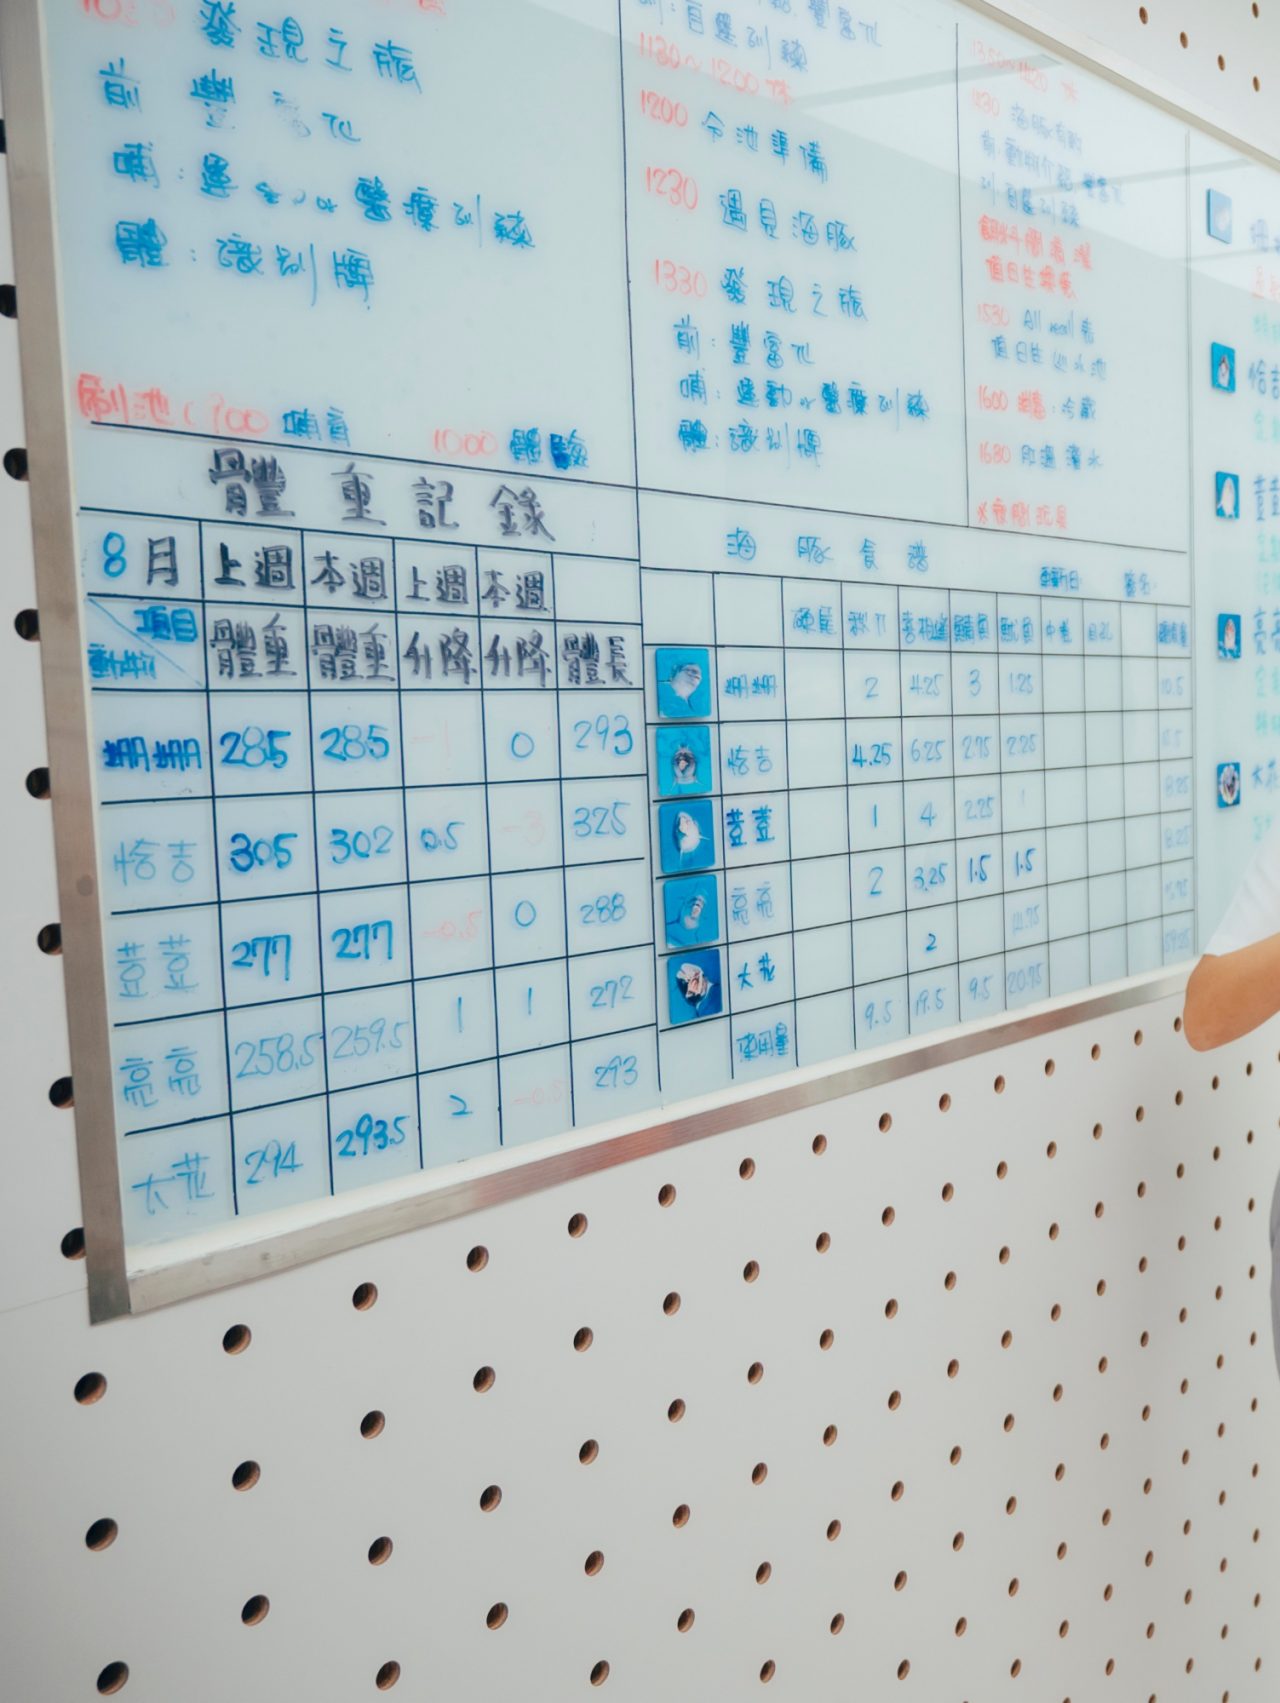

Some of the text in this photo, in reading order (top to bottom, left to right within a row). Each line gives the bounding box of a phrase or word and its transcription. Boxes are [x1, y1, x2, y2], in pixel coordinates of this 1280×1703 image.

[640, 89, 689, 128] 1200
[646, 167, 698, 210] 1230
[655, 259, 867, 321] 1330 發現之旅
[433, 428, 498, 455] 1000
[208, 447, 555, 542] 體重記錄
[214, 542, 295, 589] 上週
[310, 551, 388, 600] 本週
[406, 564, 468, 604] 上週
[481, 570, 551, 612] 本週
[209, 613, 298, 679] 體重
[312, 624, 395, 681] 體重
[403, 628, 476, 684] 升降
[485, 632, 551, 687] 升降
[562, 633, 633, 686] 體長
[864, 676, 880, 698] 2
[968, 668, 983, 697] 3
[219, 727, 291, 769] 285
[320, 725, 390, 762] 285
[510, 731, 535, 758] 0
[573, 714, 634, 756] 293
[852, 742, 893, 768] 4.25
[573, 801, 631, 837] 325
[920, 801, 937, 827] 4
[229, 832, 298, 872] 305
[329, 825, 395, 864] 302
[419, 820, 465, 855] 0.5
[868, 866, 885, 896] 2
[913, 862, 948, 892] 3.25
[968, 853, 992, 883] 1.5
[1014, 847, 1037, 877] 1.5
[514, 900, 537, 927] 0
[580, 892, 627, 925] 288
[231, 934, 292, 982] 277
[331, 920, 395, 961] 277
[925, 932, 938, 952] 2
[590, 974, 635, 1009] 272
[234, 1032, 324, 1079] 258.5
[332, 1020, 410, 1061] 259.5
[594, 1055, 639, 1090] 293
[449, 1094, 474, 1117] 2
[335, 1113, 411, 1157] 293.5
[245, 1139, 305, 1185] 294
